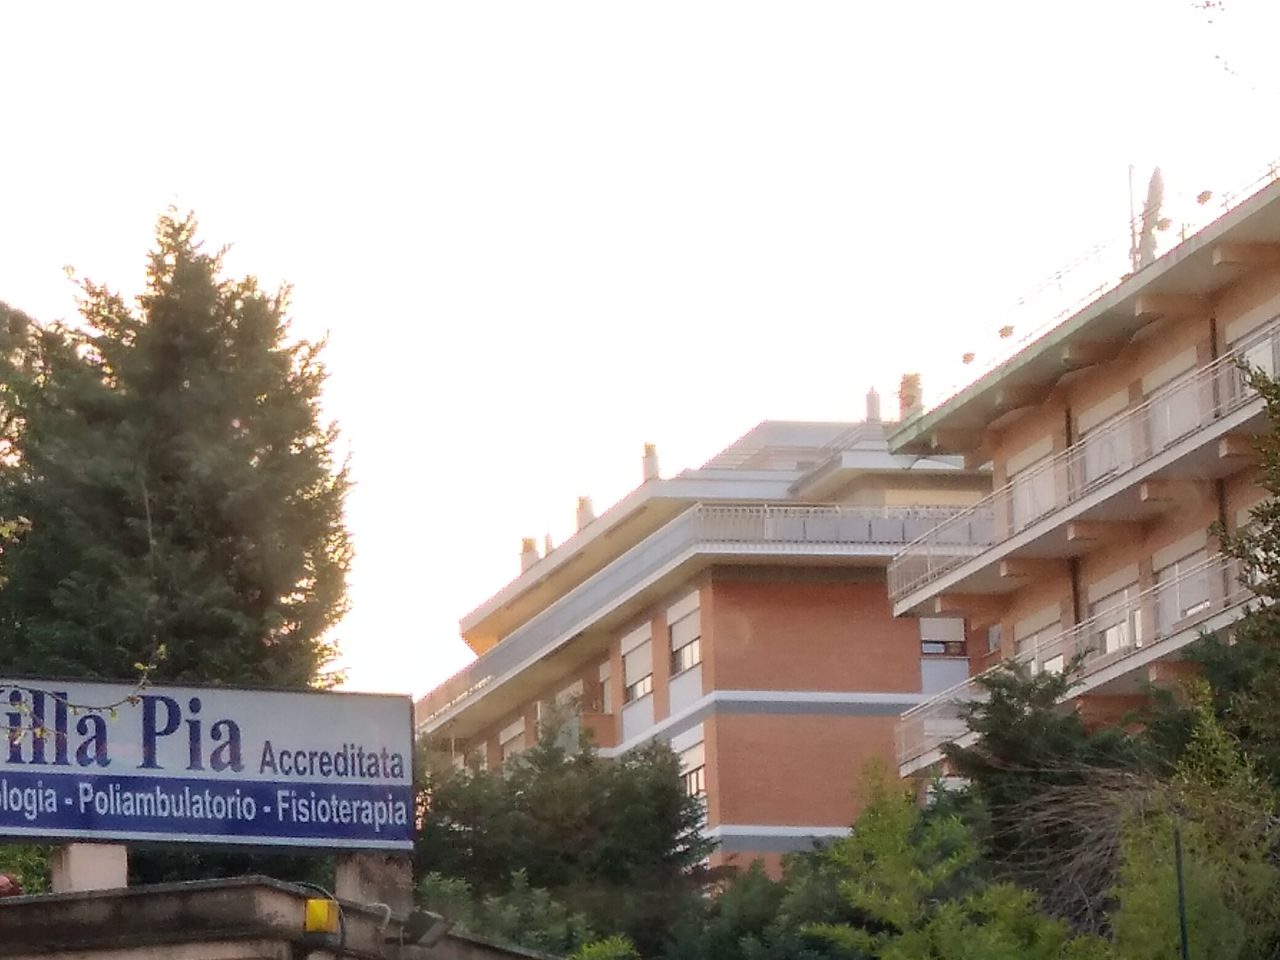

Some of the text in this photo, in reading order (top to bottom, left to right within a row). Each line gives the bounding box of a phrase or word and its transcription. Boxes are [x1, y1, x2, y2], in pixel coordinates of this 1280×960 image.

[136, 694, 245, 773] Pia
[259, 740, 404, 779] Accreditata
[79, 782, 256, 821] Poliambulatorio
[277, 790, 407, 832] Fisioterapia
